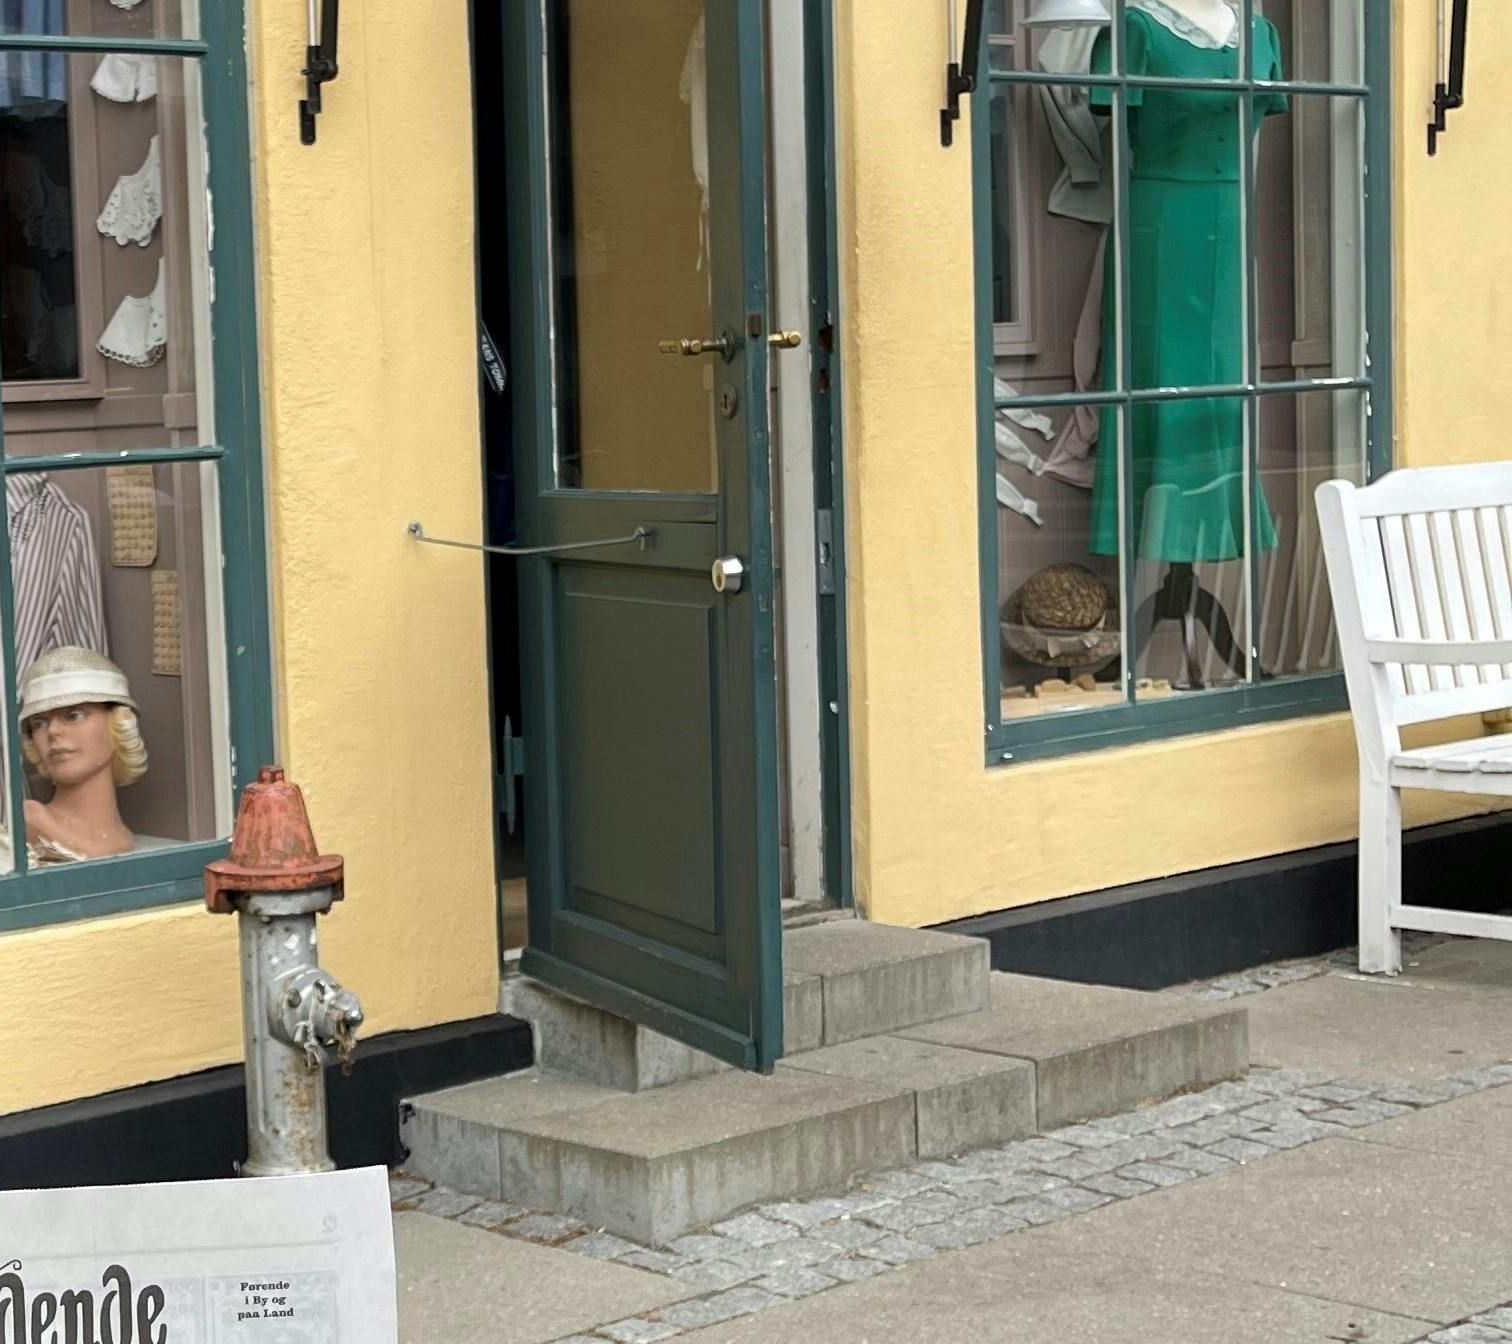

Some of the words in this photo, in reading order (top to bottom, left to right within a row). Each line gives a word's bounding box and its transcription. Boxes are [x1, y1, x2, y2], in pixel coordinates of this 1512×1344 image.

[240, 1281, 290, 1291] Førende
[245, 1296, 249, 1304] i
[253, 1296, 268, 1306] By
[272, 1297, 286, 1305] og
[238, 1312, 260, 1321] paa
[264, 1308, 294, 1318] Land
